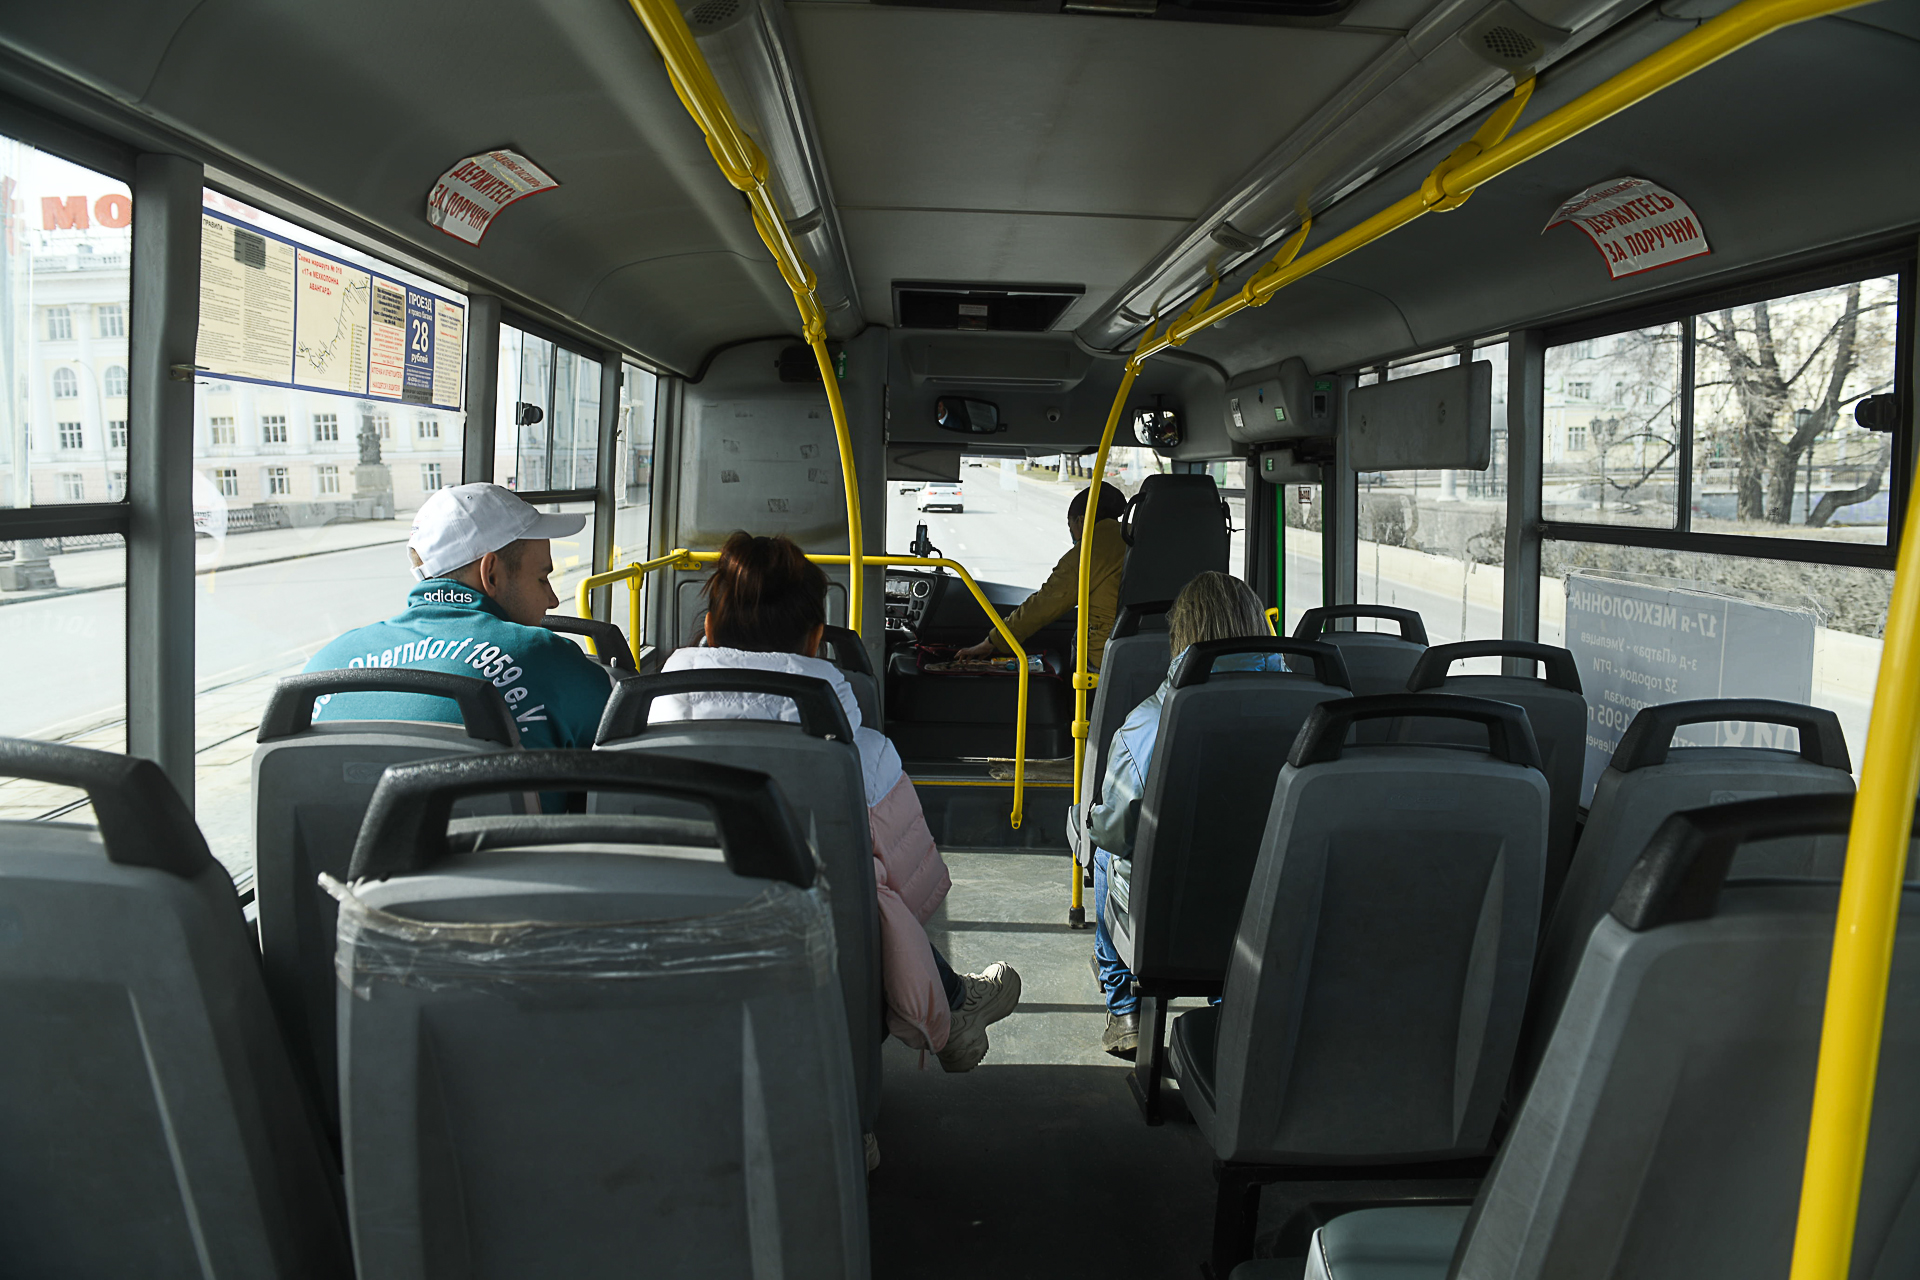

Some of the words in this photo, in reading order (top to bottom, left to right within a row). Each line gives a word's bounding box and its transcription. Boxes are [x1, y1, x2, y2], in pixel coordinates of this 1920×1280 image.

[449, 161, 517, 204] ДЕРЖИТЕСЬ
[202, 218, 223, 231] ПРАВИЛА
[430, 183, 449, 210] ЗА
[444, 191, 492, 231] ПОРУЧНИ
[1585, 193, 1675, 237] ДЕРЖИТЕСЬ
[1604, 240, 1628, 264] ЗА
[1623, 216, 1699, 257] ПОРУЧНИ
[408, 291, 432, 313] ПРОЕЗД
[412, 319, 429, 353] 28
[411, 353, 428, 364] рублей
[424, 589, 473, 603] adidas
[464, 641, 523, 688] 1959
